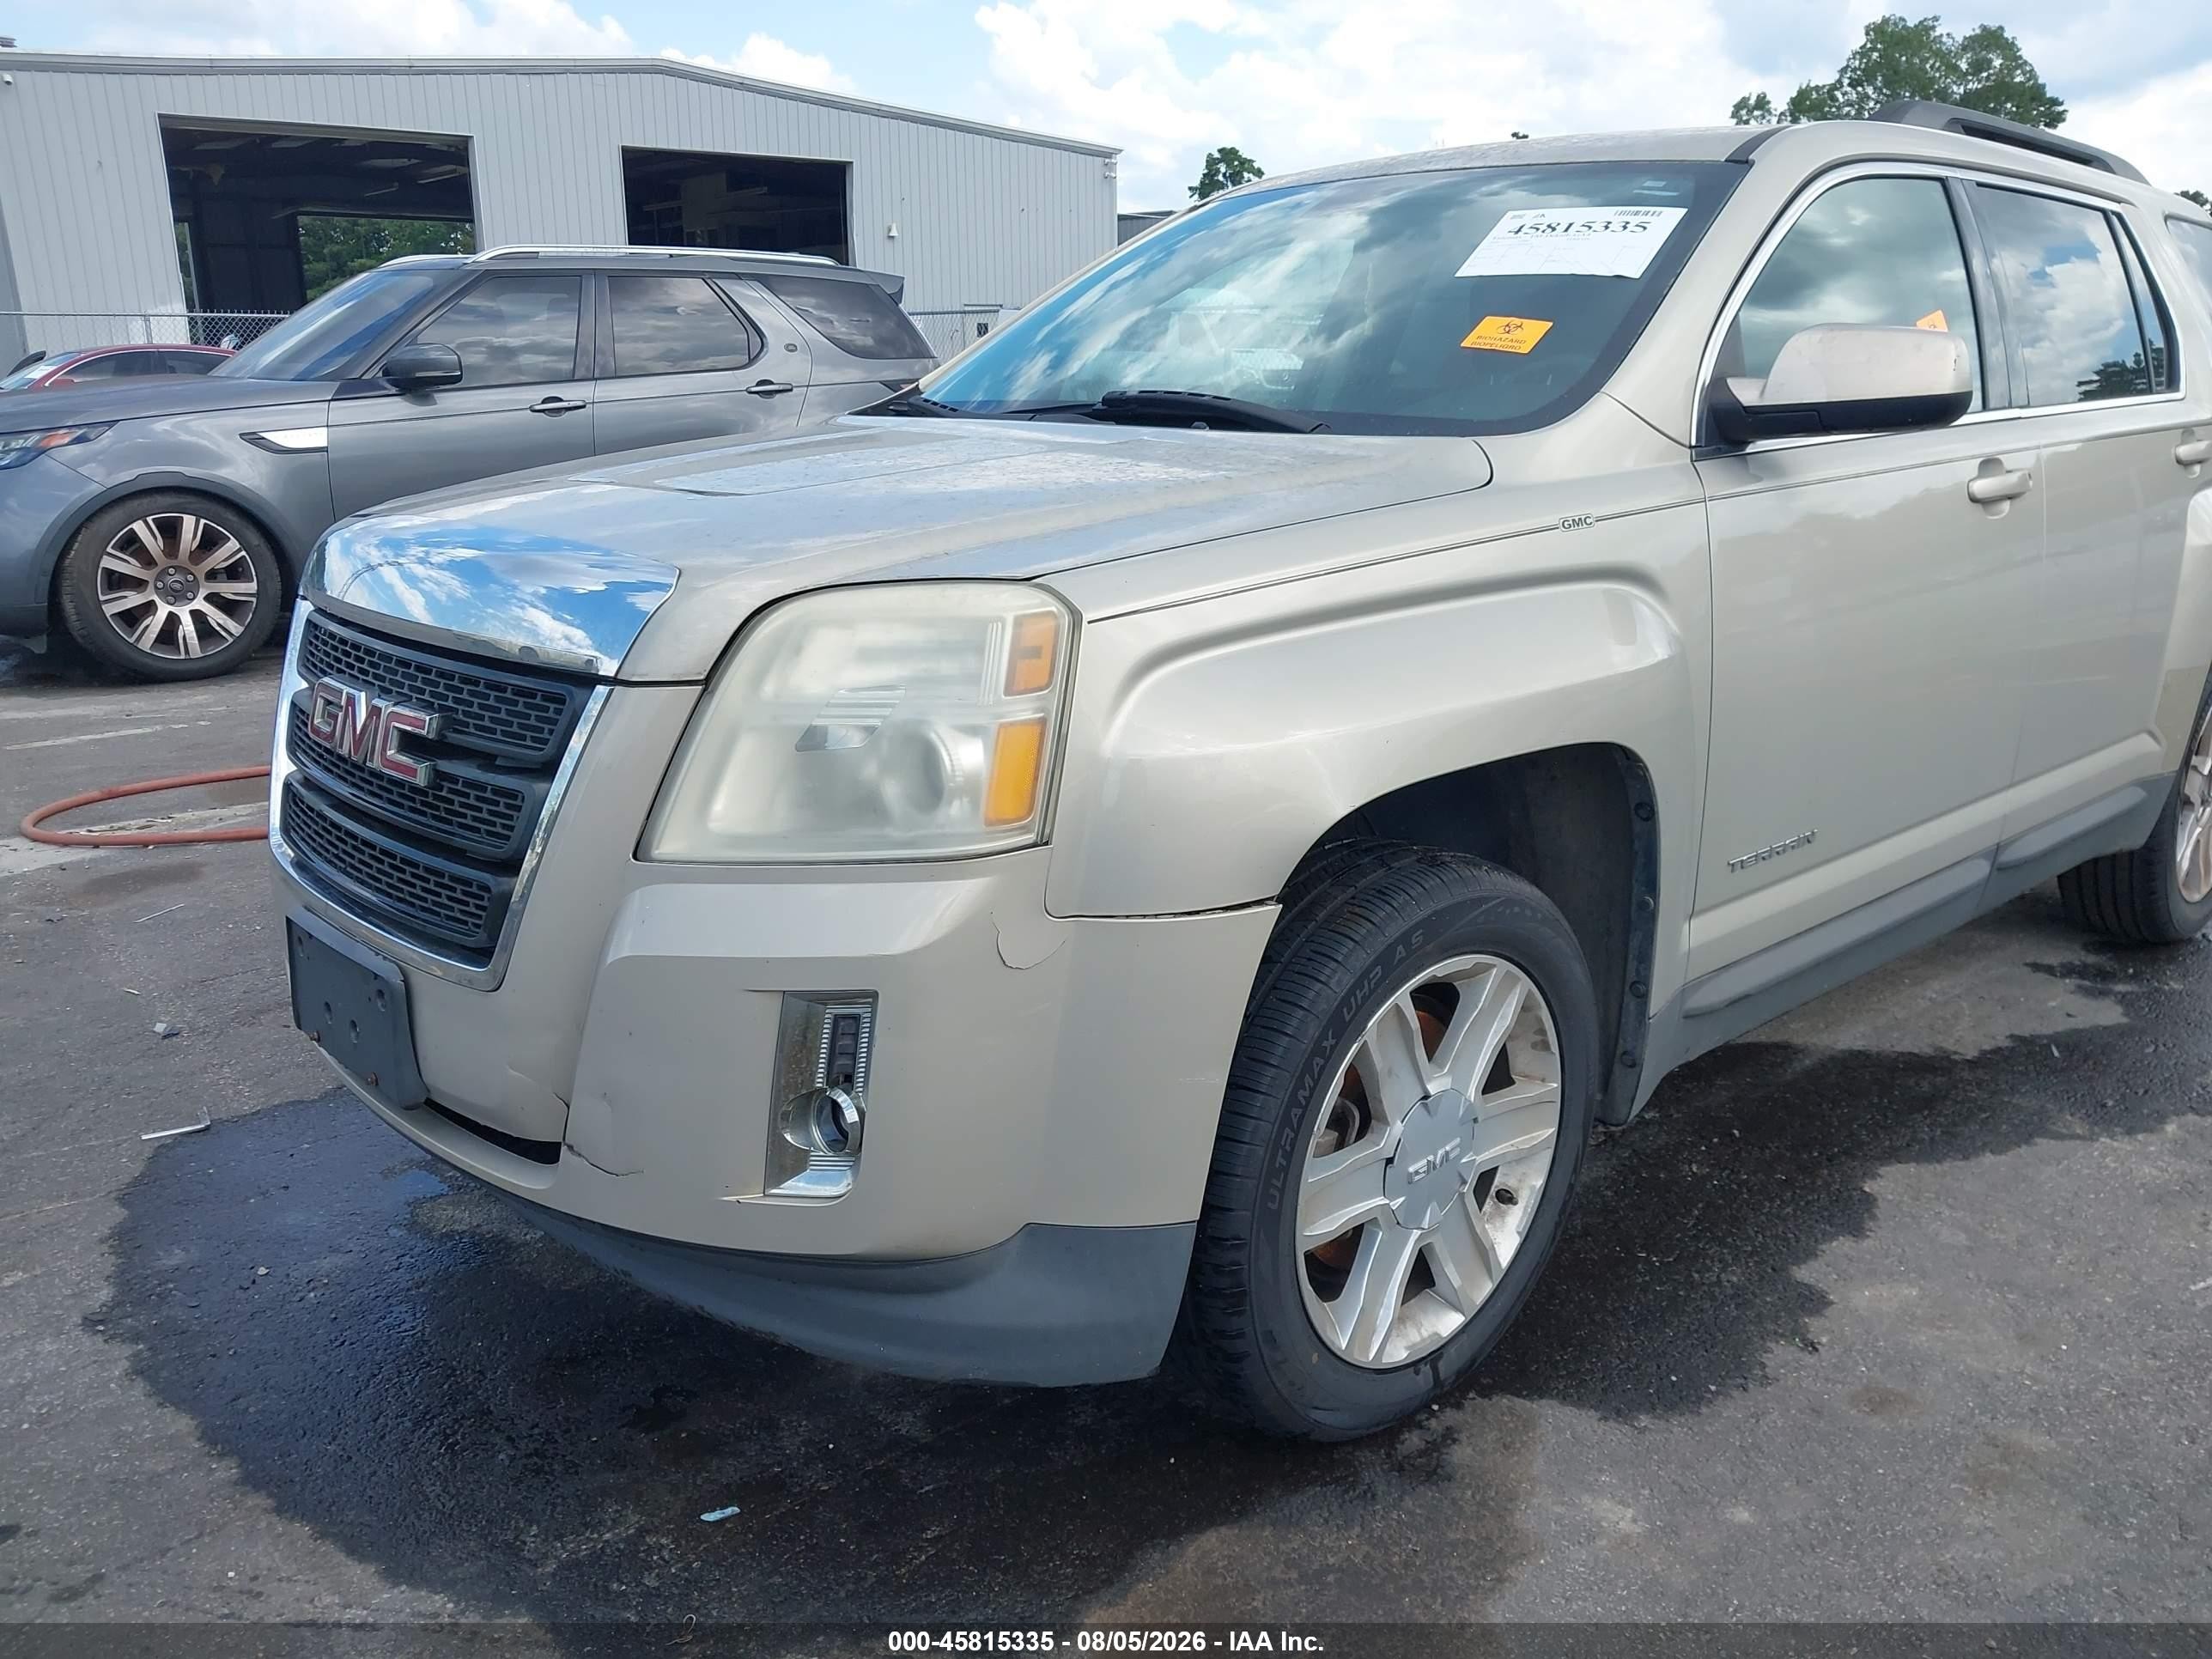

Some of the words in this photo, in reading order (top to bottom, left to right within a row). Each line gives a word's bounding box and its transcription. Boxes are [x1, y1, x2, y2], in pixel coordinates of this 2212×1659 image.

[1508, 221, 1651, 235] 45815335
[1470, 341, 1522, 350] BIOPELIGRO
[1476, 335, 1527, 344] BIOHAZARD
[1561, 515, 1593, 530] GMC
[309, 676, 439, 787] GMC
[1727, 829, 1818, 873] TERRAIN
[1267, 1030, 1336, 1210] ULTRAMAX
[1341, 964, 1382, 1024] UHP
[1408, 1138, 1461, 1184] GMC
